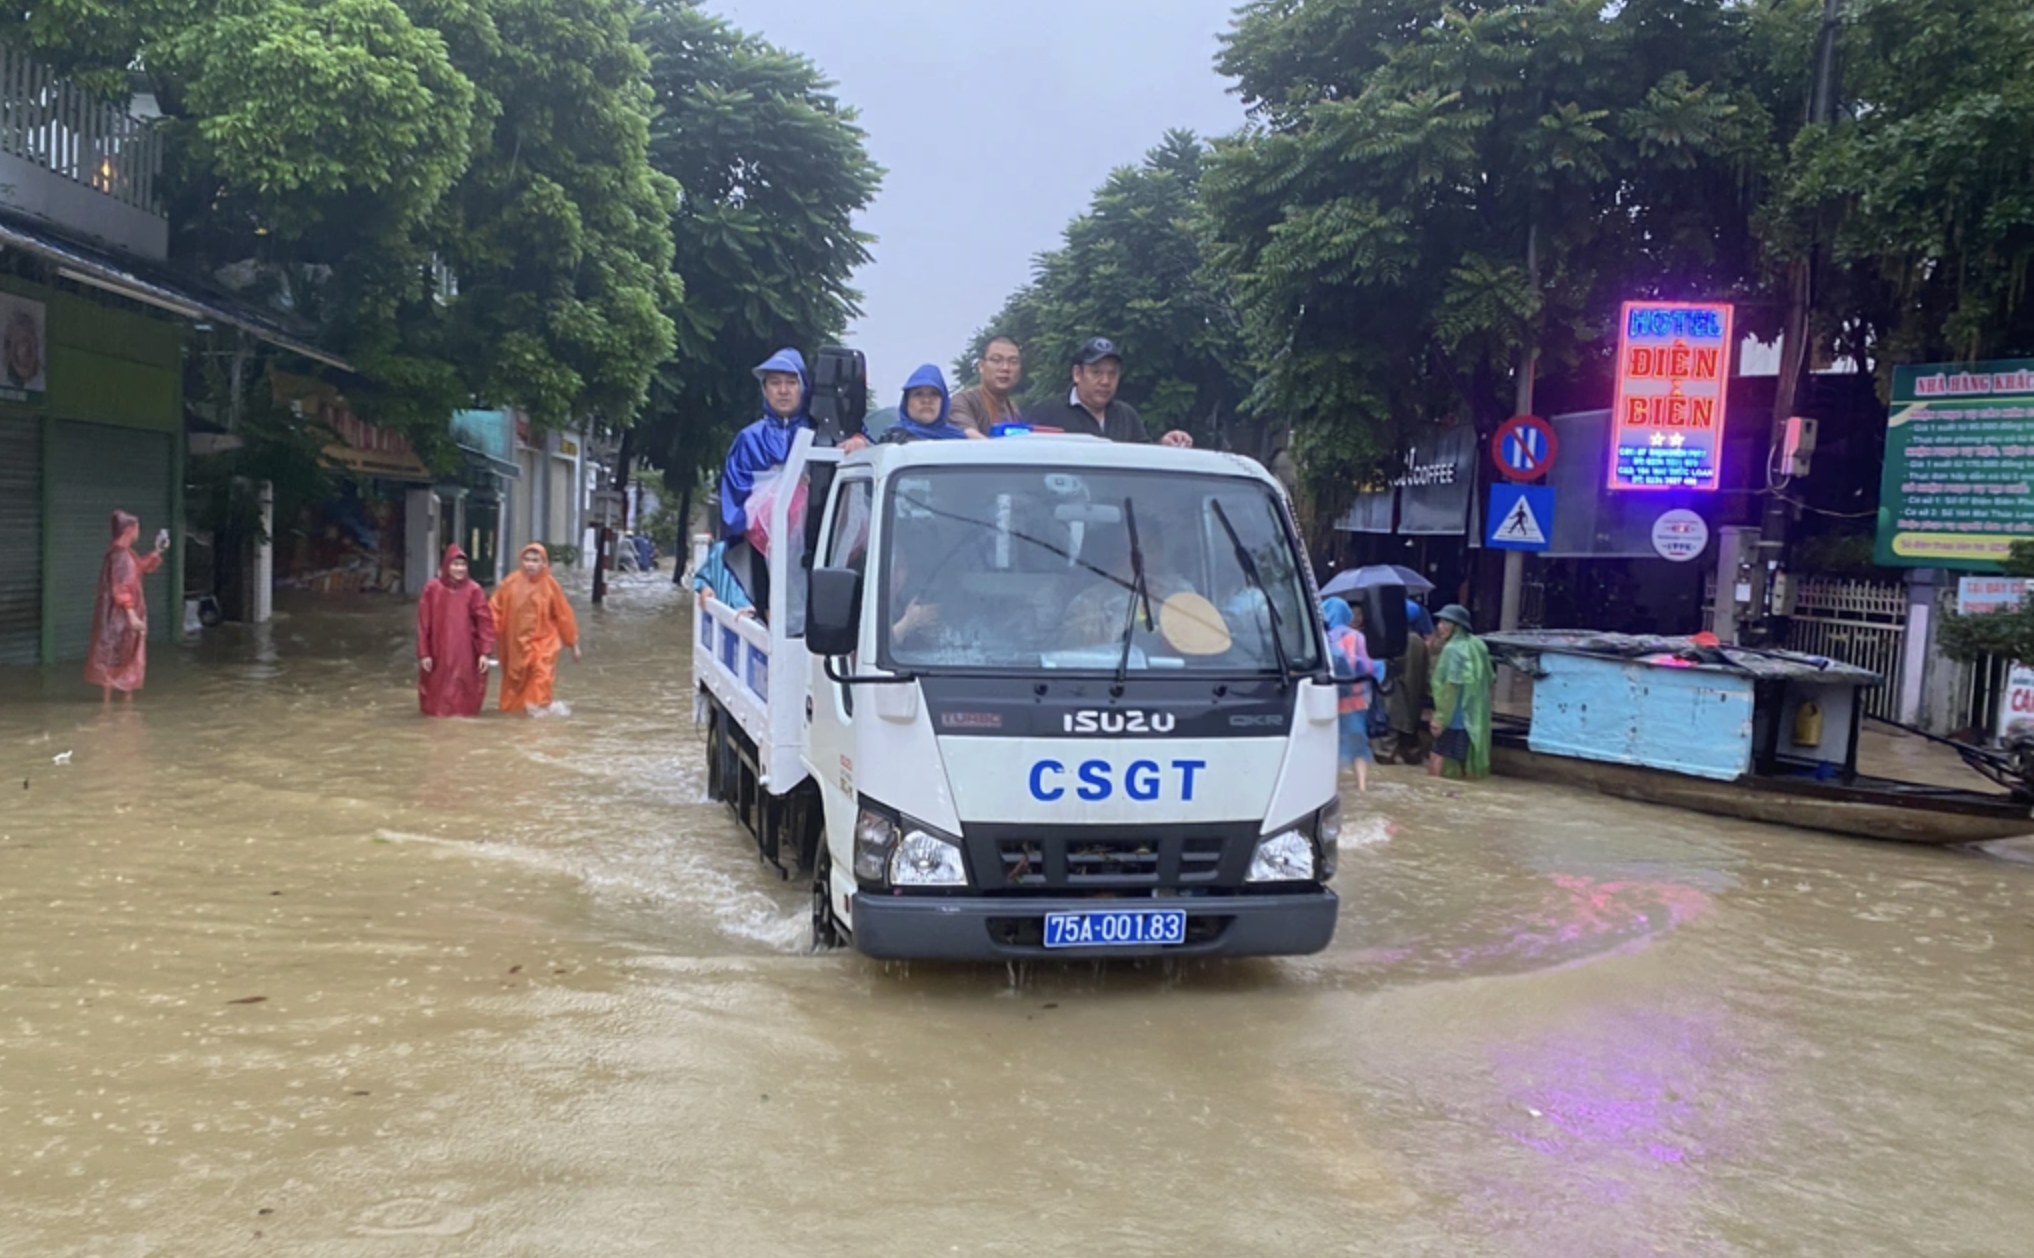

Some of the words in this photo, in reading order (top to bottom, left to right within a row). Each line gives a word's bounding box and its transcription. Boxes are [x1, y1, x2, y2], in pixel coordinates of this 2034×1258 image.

[1629, 309, 1722, 337] HOTEL
[1915, 372, 1946, 395] NHÀ
[1949, 371, 1991, 394] HÀNG
[1626, 388, 1714, 427] BIÊN
[1413, 463, 1454, 486] COFFEE
[941, 712, 1002, 727] TURBO
[1063, 710, 1175, 732] ISUZU
[1229, 714, 1284, 727] QKR
[1028, 758, 1207, 802] CSGT
[1050, 913, 1180, 944] 75A-001.83
